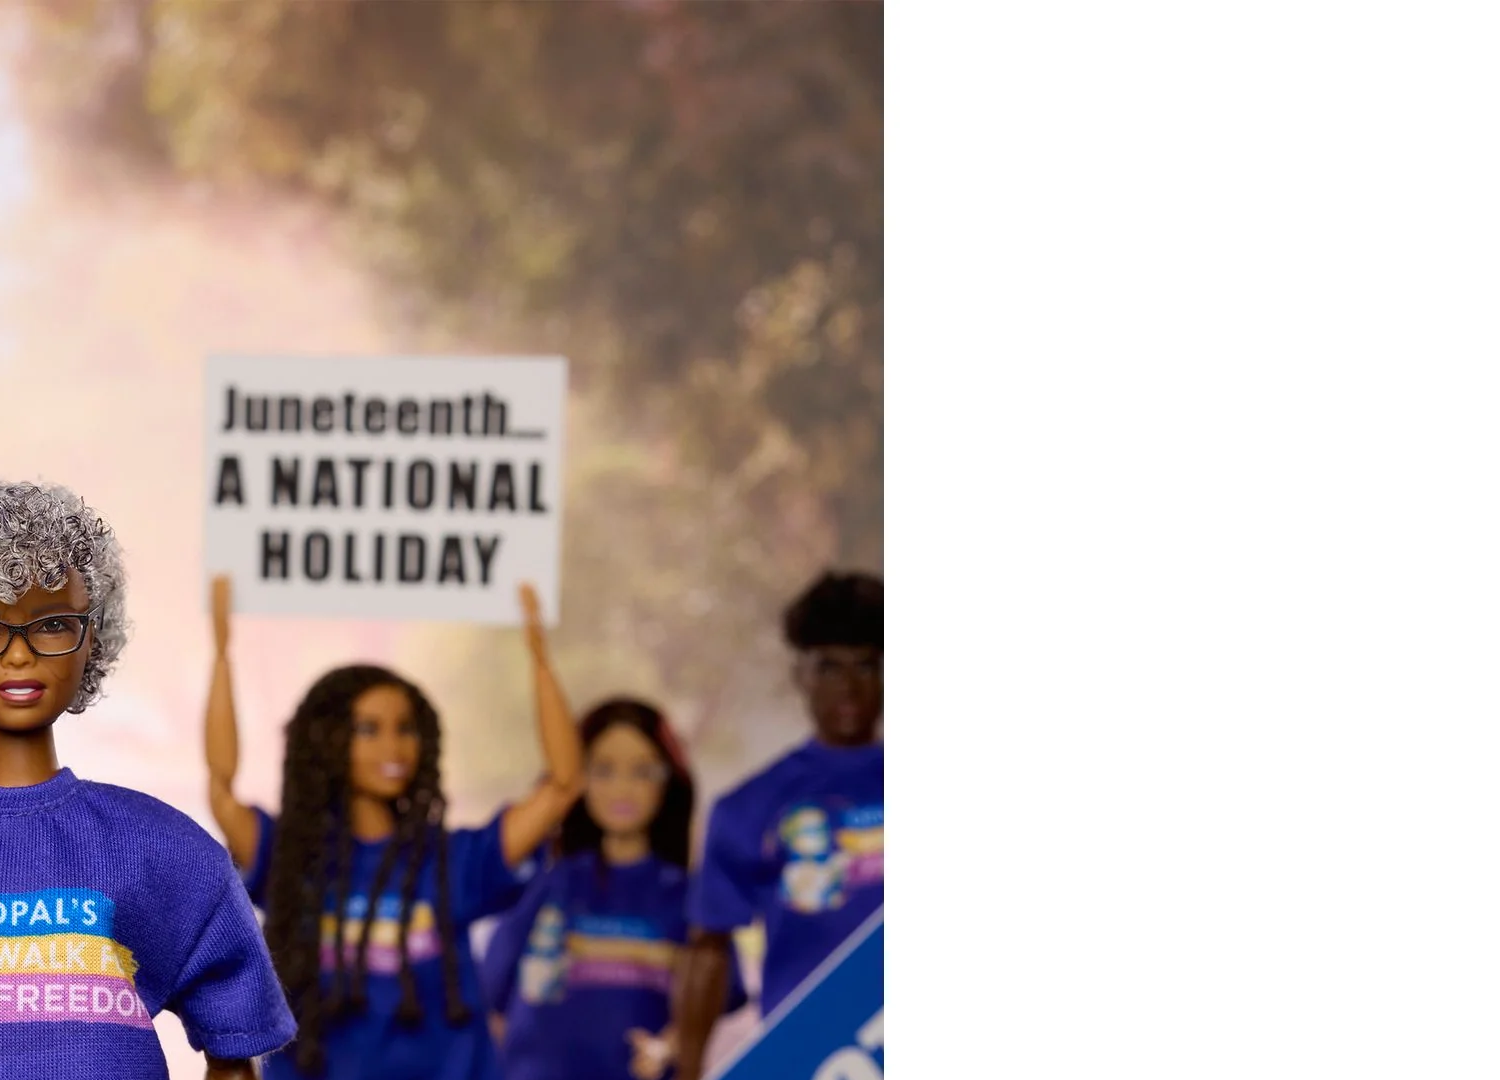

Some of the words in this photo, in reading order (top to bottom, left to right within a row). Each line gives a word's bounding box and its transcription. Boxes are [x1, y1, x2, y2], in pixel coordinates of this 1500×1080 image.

[214, 456, 245, 508] A
[270, 456, 548, 513] NATIONAL
[260, 530, 500, 586] HOLIDAY
